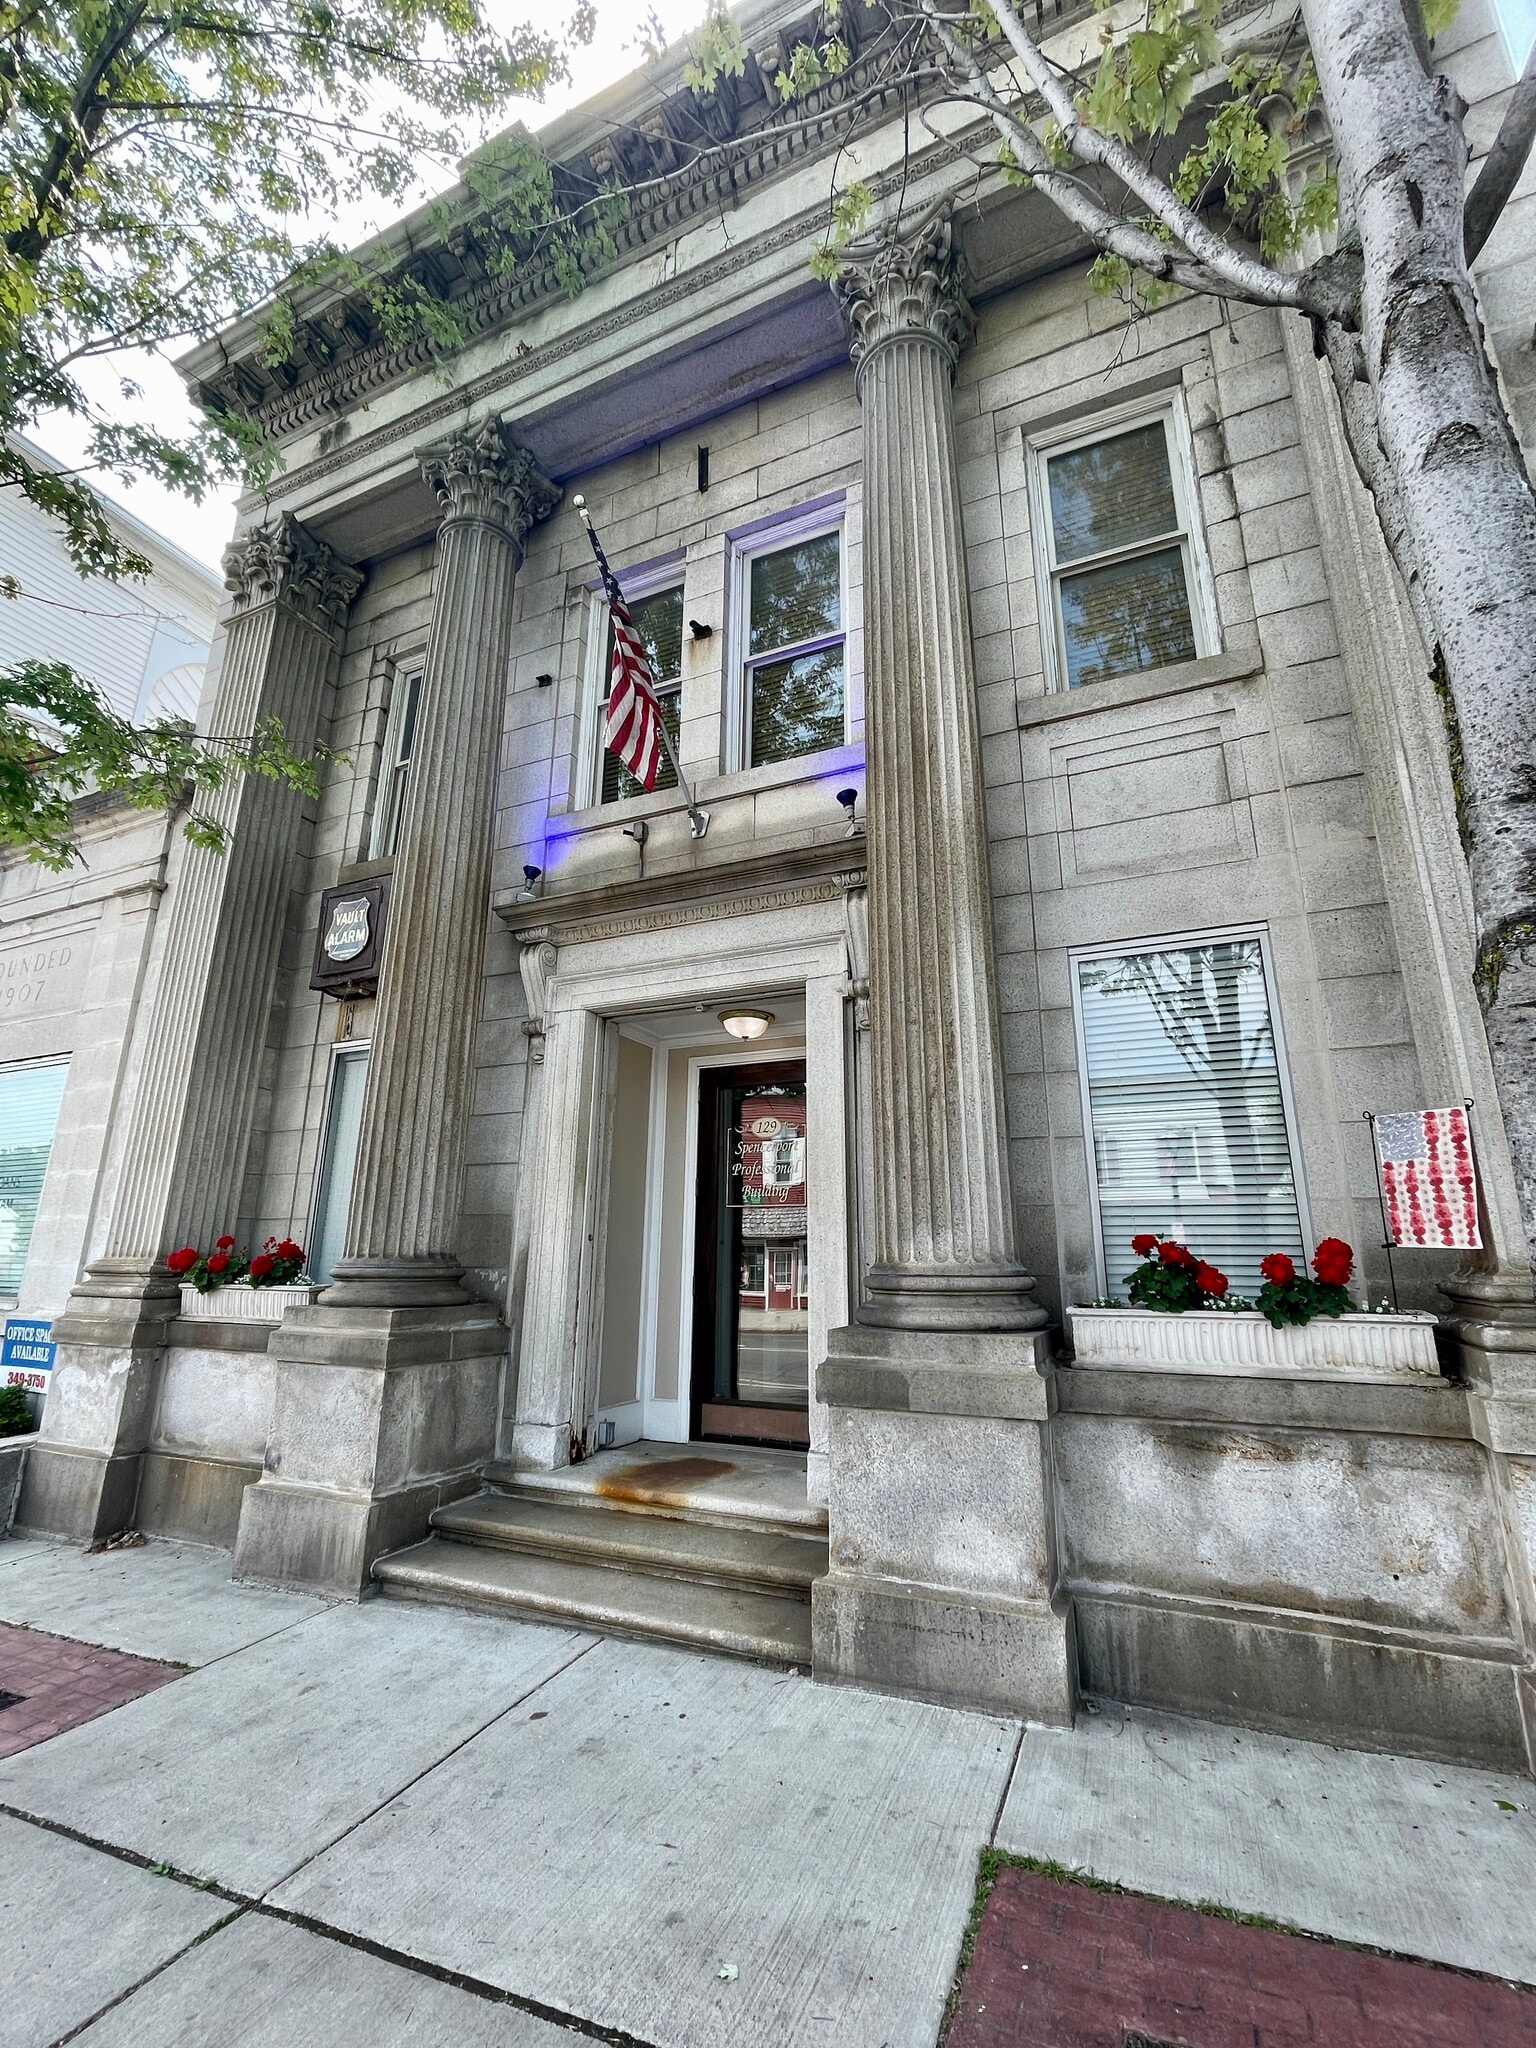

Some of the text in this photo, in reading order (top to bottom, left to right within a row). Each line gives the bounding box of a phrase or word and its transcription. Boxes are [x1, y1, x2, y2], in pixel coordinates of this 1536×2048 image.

[336, 908, 366, 926] VAULT
[327, 928, 366, 946] ALARM
[756, 1120, 777, 1134] 129
[734, 1140, 799, 1159] Spencerport
[732, 1159, 802, 1181] Professional
[741, 1184, 790, 1203] Building
[7, 1326, 56, 1343] OFFICE SPAC
[10, 1345, 50, 1362] AVAILABLE
[7, 1371, 46, 1389] 349-3750
